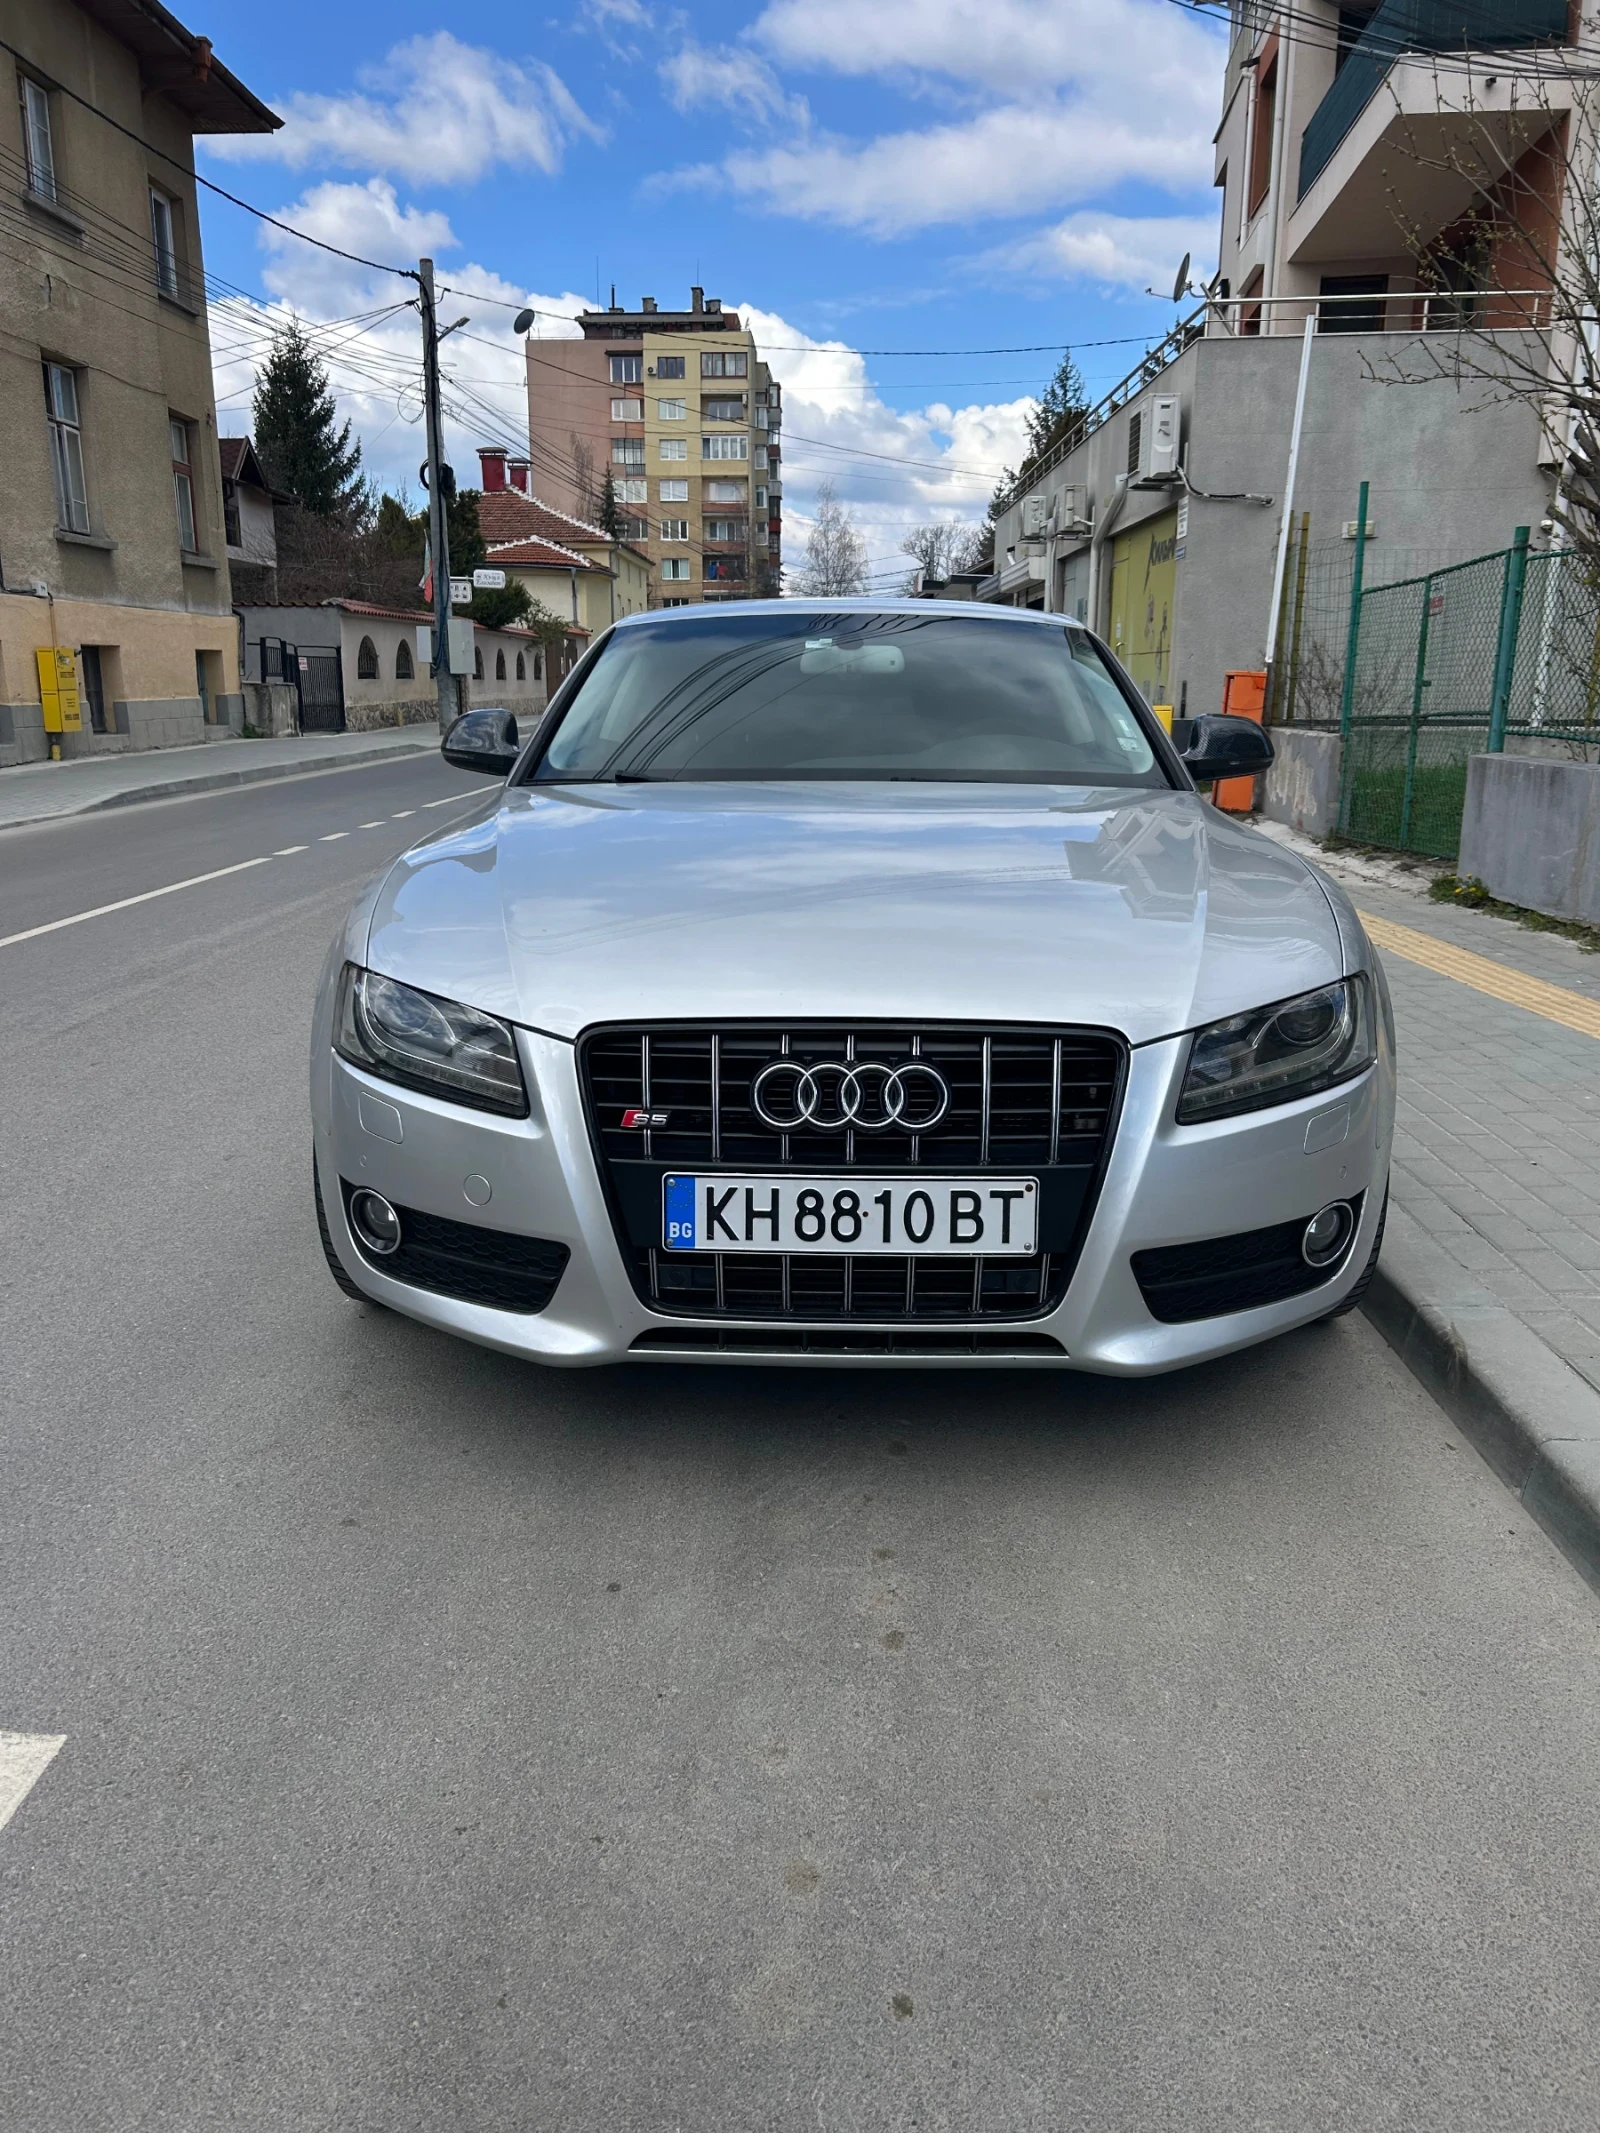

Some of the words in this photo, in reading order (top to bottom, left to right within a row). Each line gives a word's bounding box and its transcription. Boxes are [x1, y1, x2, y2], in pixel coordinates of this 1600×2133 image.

[632, 1113, 668, 1126] S5
[705, 1186, 780, 1242] KH
[794, 1188, 935, 1244] 8810
[949, 1189, 1025, 1245] BT
[669, 1222, 693, 1239] BG
